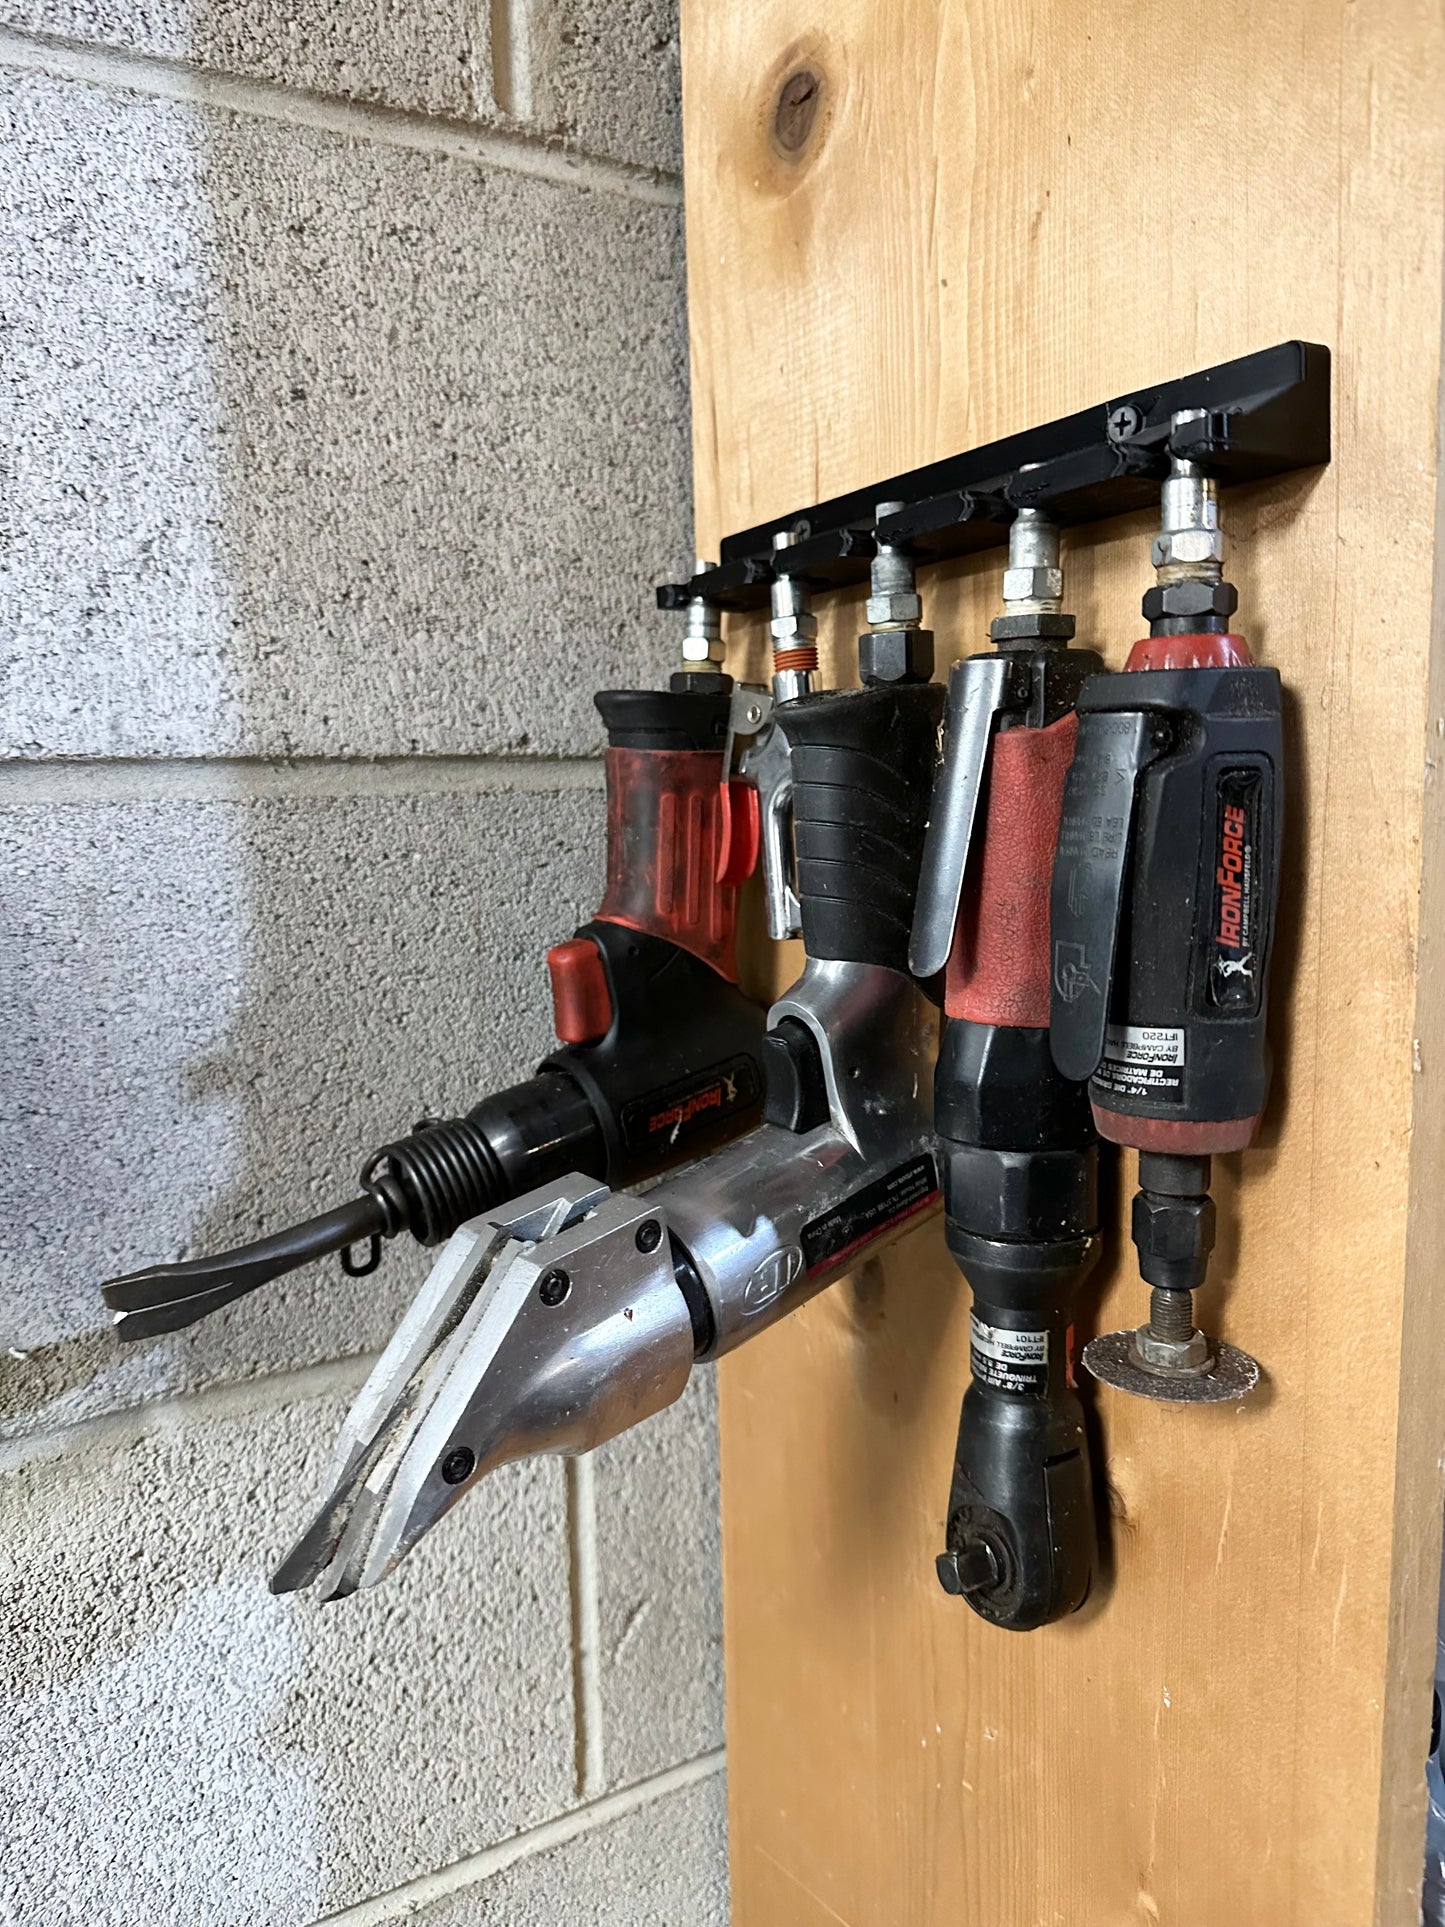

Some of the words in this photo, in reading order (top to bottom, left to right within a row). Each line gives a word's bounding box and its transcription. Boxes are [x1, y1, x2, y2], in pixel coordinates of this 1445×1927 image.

[1242, 895, 1250, 936] CAMPBELL
[1142, 1032, 1178, 1041] IFT220
[1121, 1042, 1163, 1052] CAMPBELL
[1107, 1063, 1148, 1076] MATRICES
[1150, 1069, 1163, 1077] DE
[1112, 1073, 1179, 1086] RECTIFICADORA
[1114, 1084, 1126, 1092] DIE
[996, 1341, 1033, 1351] CAMPBELL
[996, 1362, 1008, 1371] DE
[988, 1368, 1037, 1382] TRINQUETE
[987, 1376, 1001, 1388] AIR
